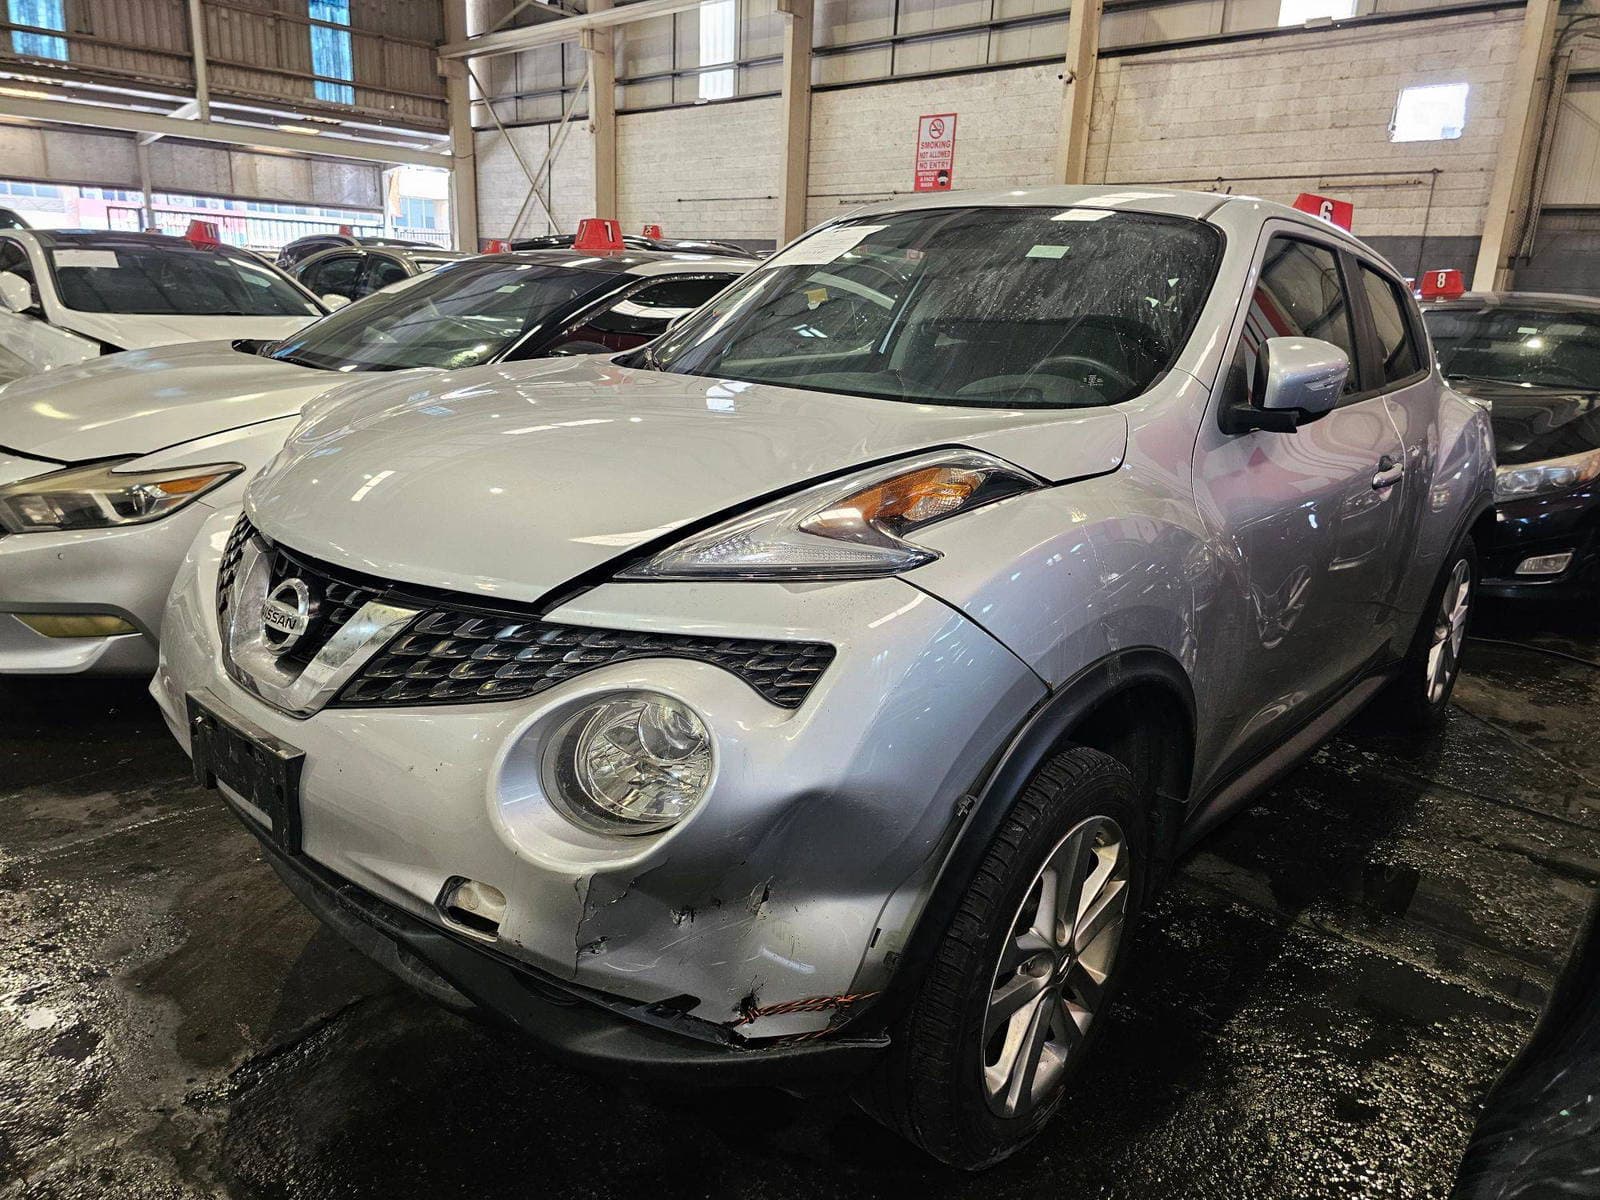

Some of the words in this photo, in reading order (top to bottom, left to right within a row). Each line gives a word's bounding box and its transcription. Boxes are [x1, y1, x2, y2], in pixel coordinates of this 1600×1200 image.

[921, 140, 951, 149] SMOKING
[929, 151, 951, 159] ALLOWED
[929, 161, 949, 169] ENTRY
[1319, 200, 1333, 222] 6
[604, 221, 613, 242] 1
[1437, 272, 1446, 288] 8
[262, 604, 297, 630] NISSAN
